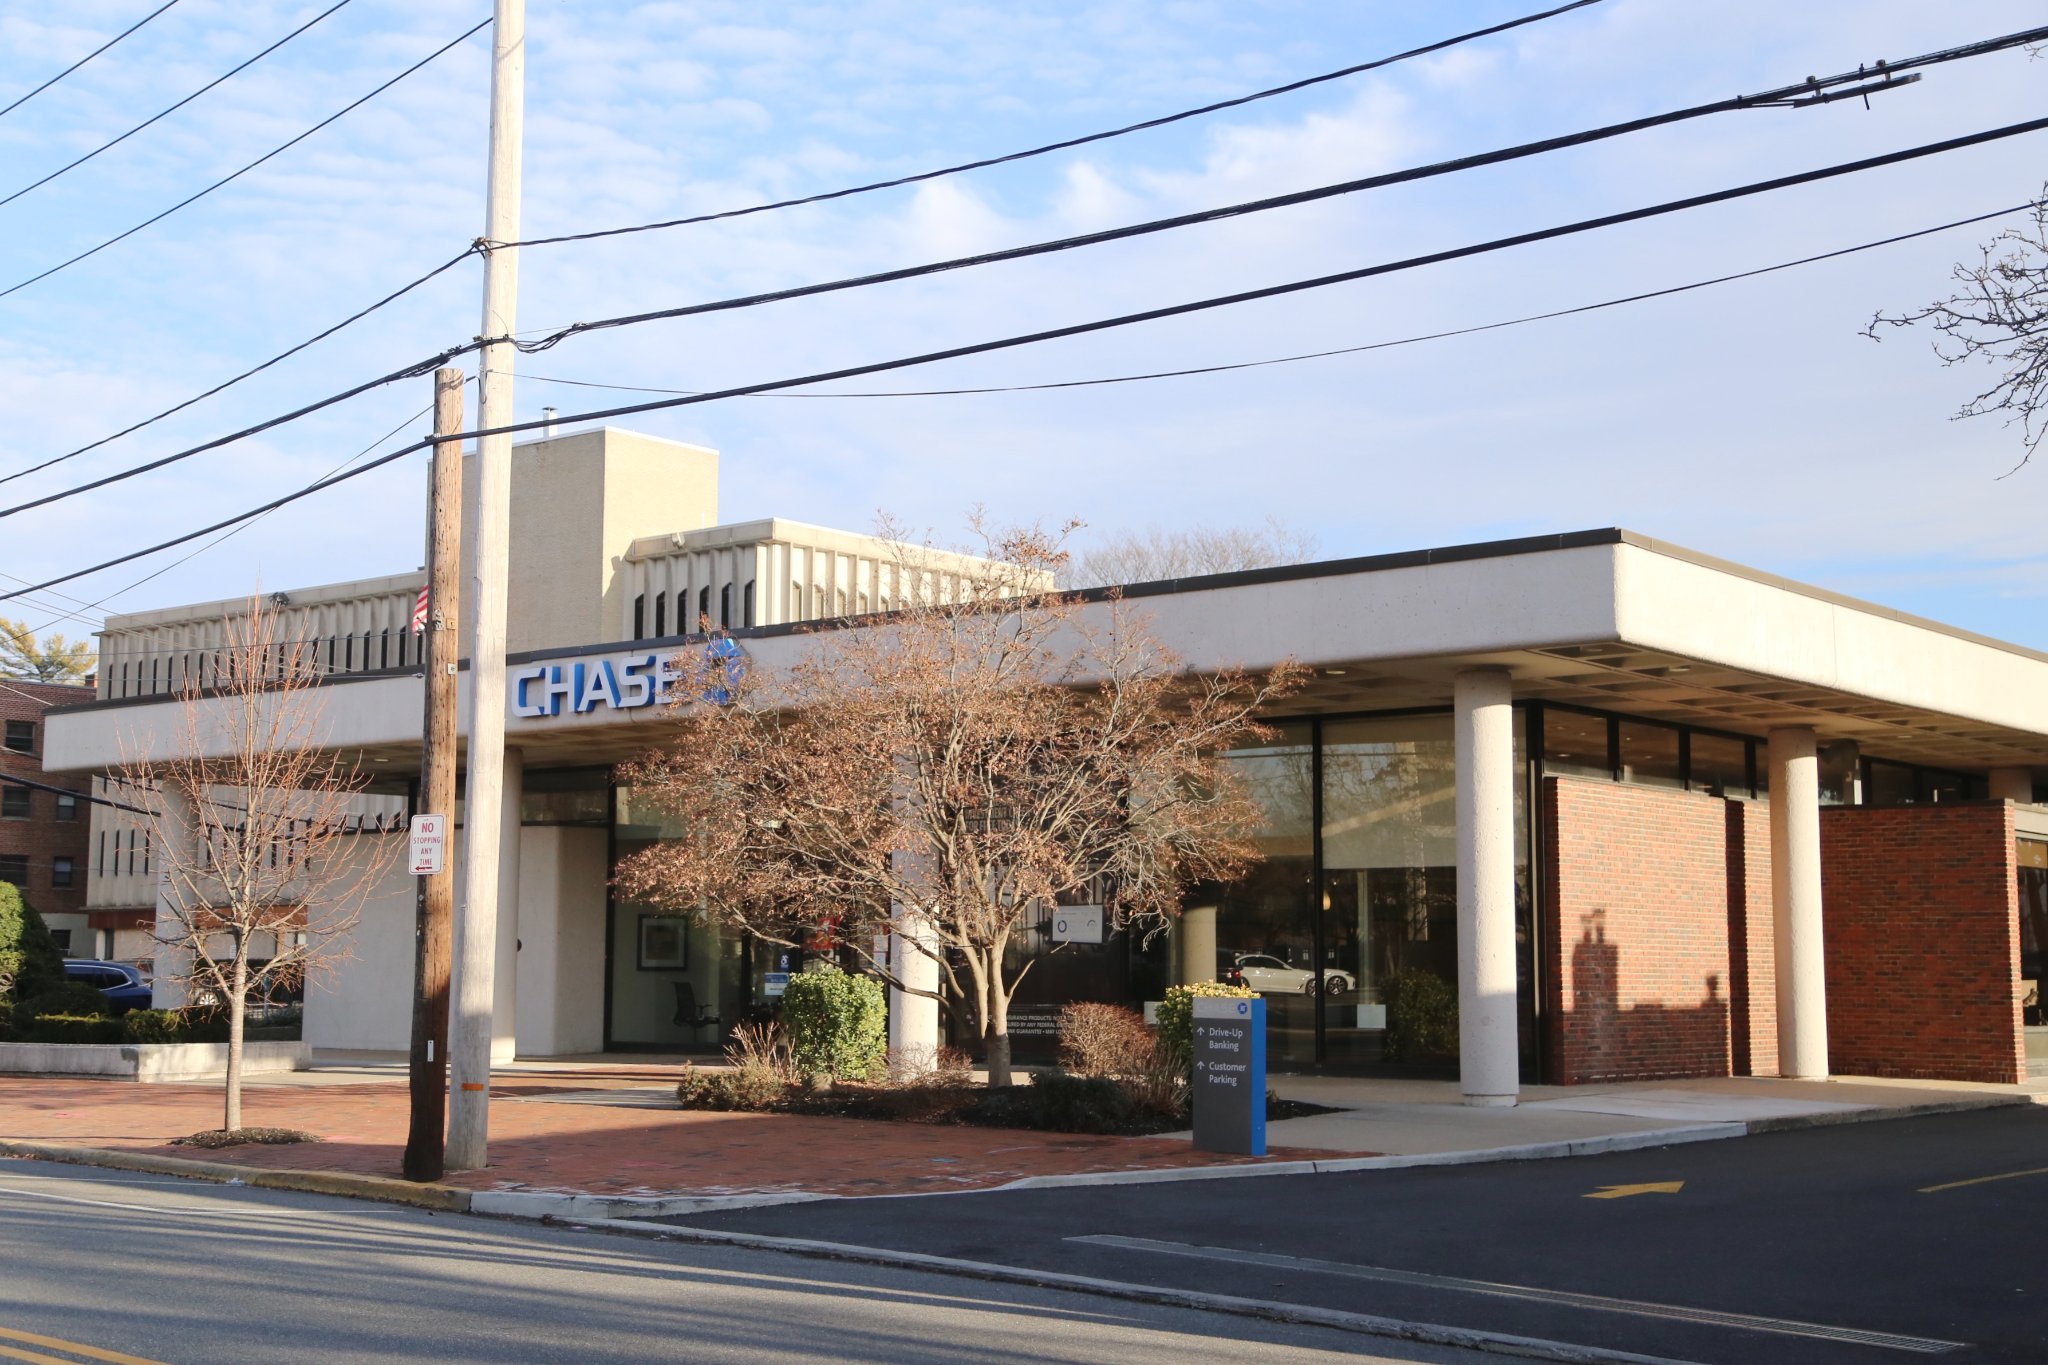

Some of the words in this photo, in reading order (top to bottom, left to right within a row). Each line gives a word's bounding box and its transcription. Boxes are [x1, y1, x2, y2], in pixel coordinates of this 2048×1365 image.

[511, 653, 683, 718] CHASE
[421, 822, 434, 833] NO
[413, 836, 441, 844] STOPPING
[420, 847, 432, 855] ANY
[420, 858, 432, 866] TIME
[1209, 1027, 1244, 1039] Drive-Up
[1209, 1040, 1239, 1052] Banking
[1208, 1061, 1246, 1071] Customer
[1209, 1074, 1237, 1087] Parking
